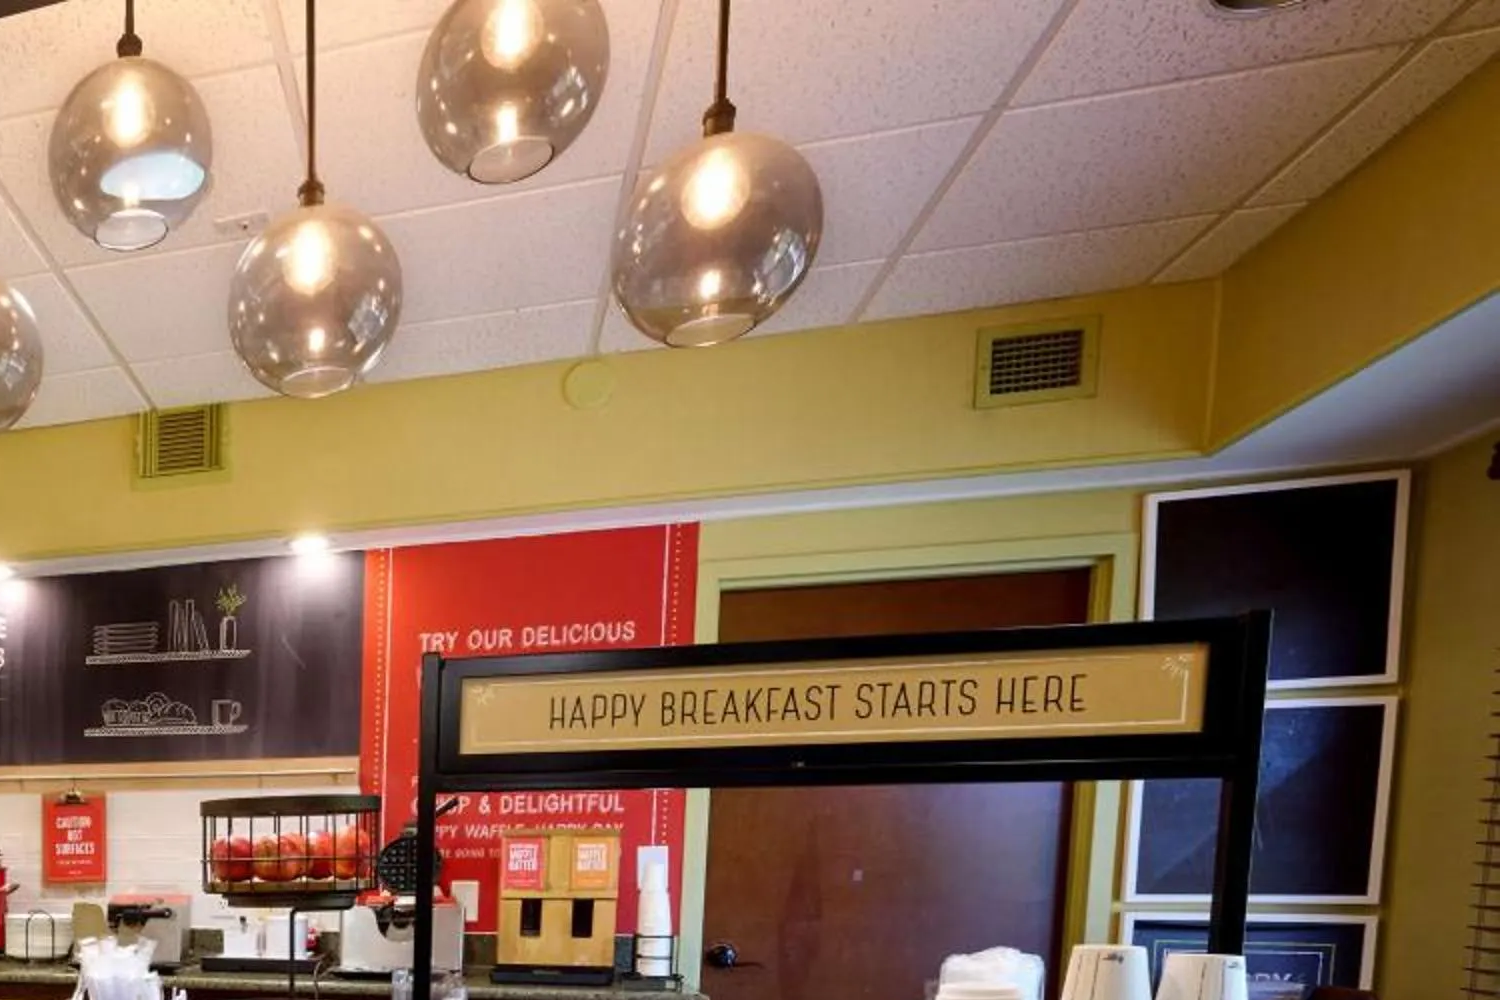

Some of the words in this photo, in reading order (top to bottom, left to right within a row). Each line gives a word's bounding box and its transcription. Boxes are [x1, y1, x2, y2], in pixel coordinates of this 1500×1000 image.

[419, 631, 459, 653] TRY
[467, 628, 513, 650] OUR
[522, 619, 636, 647] DELICIOUS
[550, 693, 646, 730] HAPPY
[661, 684, 841, 727] BREAKFAST
[855, 679, 978, 719] STARTS
[996, 673, 1088, 715] HERE
[478, 795, 491, 814] &
[500, 793, 624, 814] DELIGHTFUL
